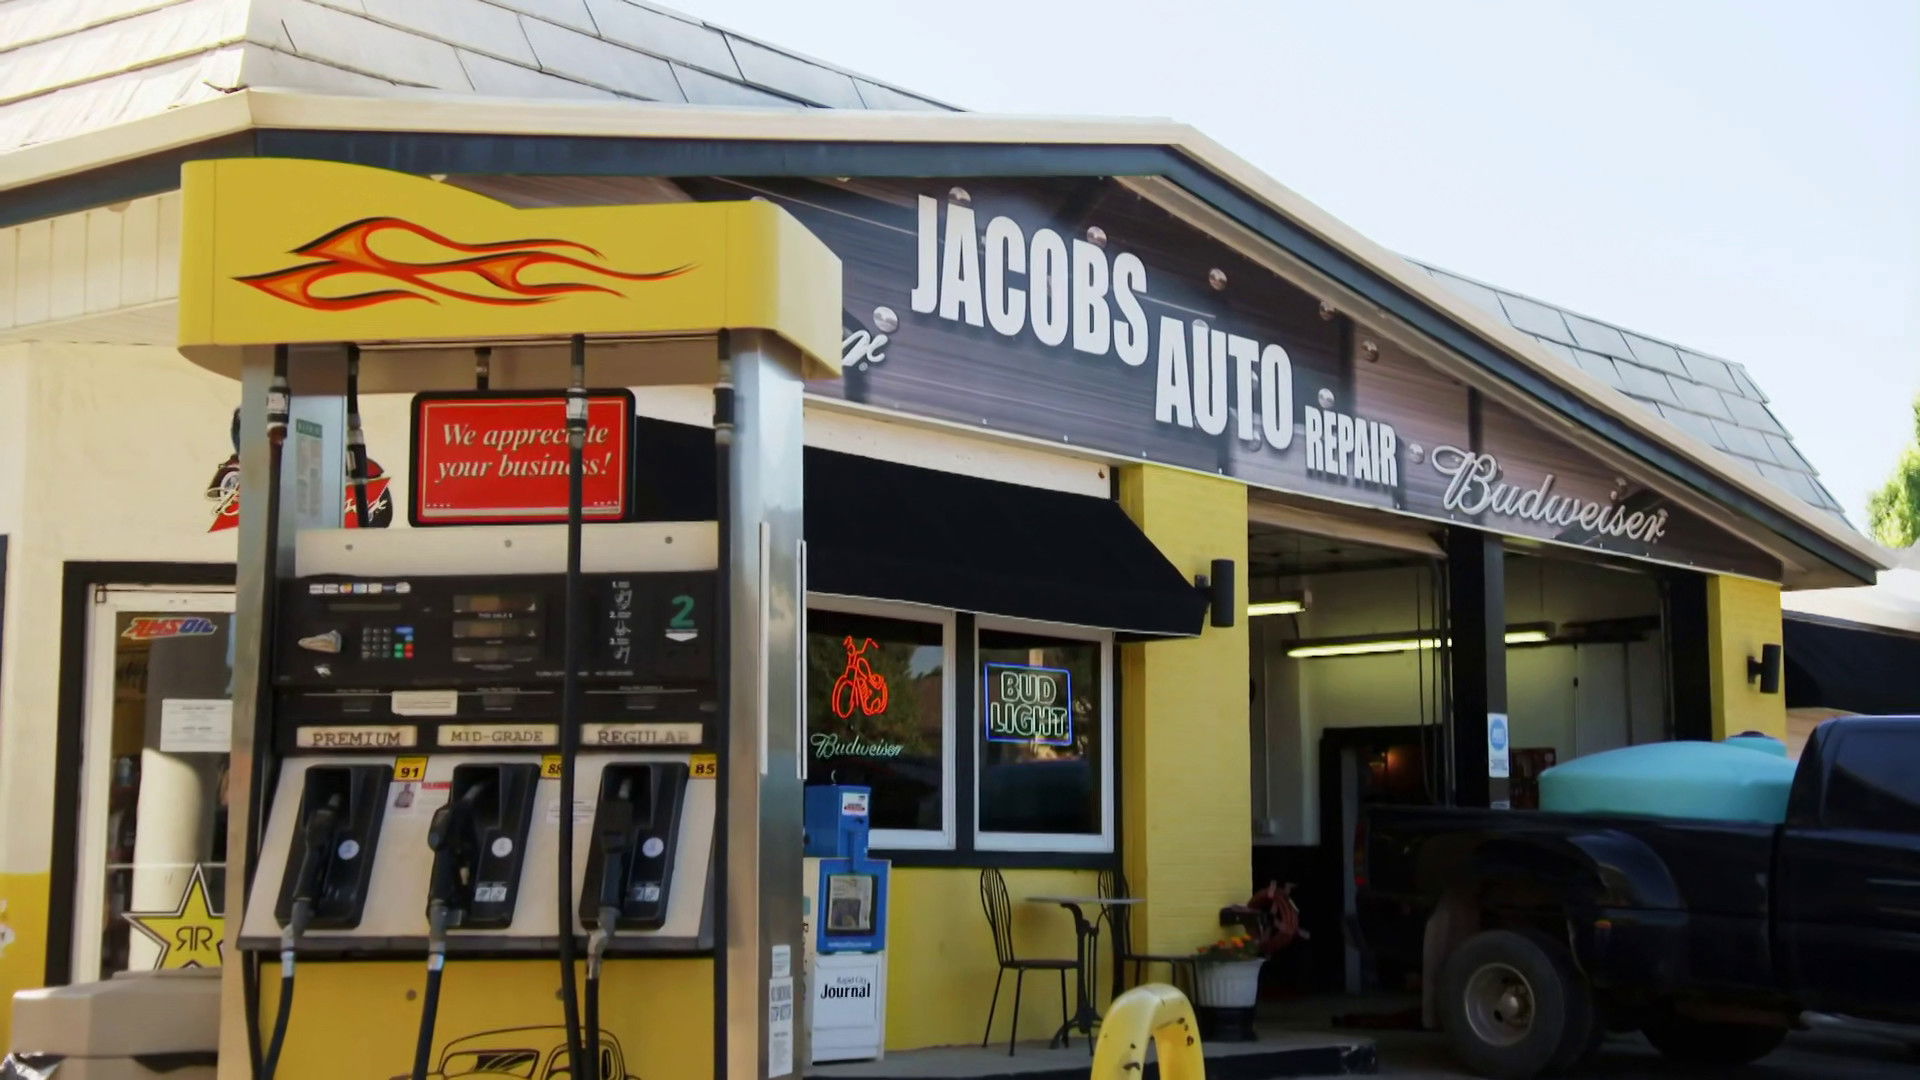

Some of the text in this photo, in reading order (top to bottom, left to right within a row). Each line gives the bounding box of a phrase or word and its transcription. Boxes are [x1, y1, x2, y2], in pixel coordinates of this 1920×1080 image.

[911, 194, 1399, 488] JACOBS AUTO REPAIR
[443, 424, 609, 450] We apprecite
[434, 452, 613, 483] your businss!
[1431, 445, 1666, 544] Budweiser
[670, 595, 695, 628] 2
[1000, 671, 1056, 705] BUD
[990, 702, 1069, 737] LIGHT
[312, 732, 400, 746] PREMIUM
[450, 731, 543, 742] MID-GRADE
[810, 733, 905, 760] Budweiser
[400, 766, 420, 778] 91
[695, 763, 715, 775] 85
[820, 982, 871, 999] Journal
